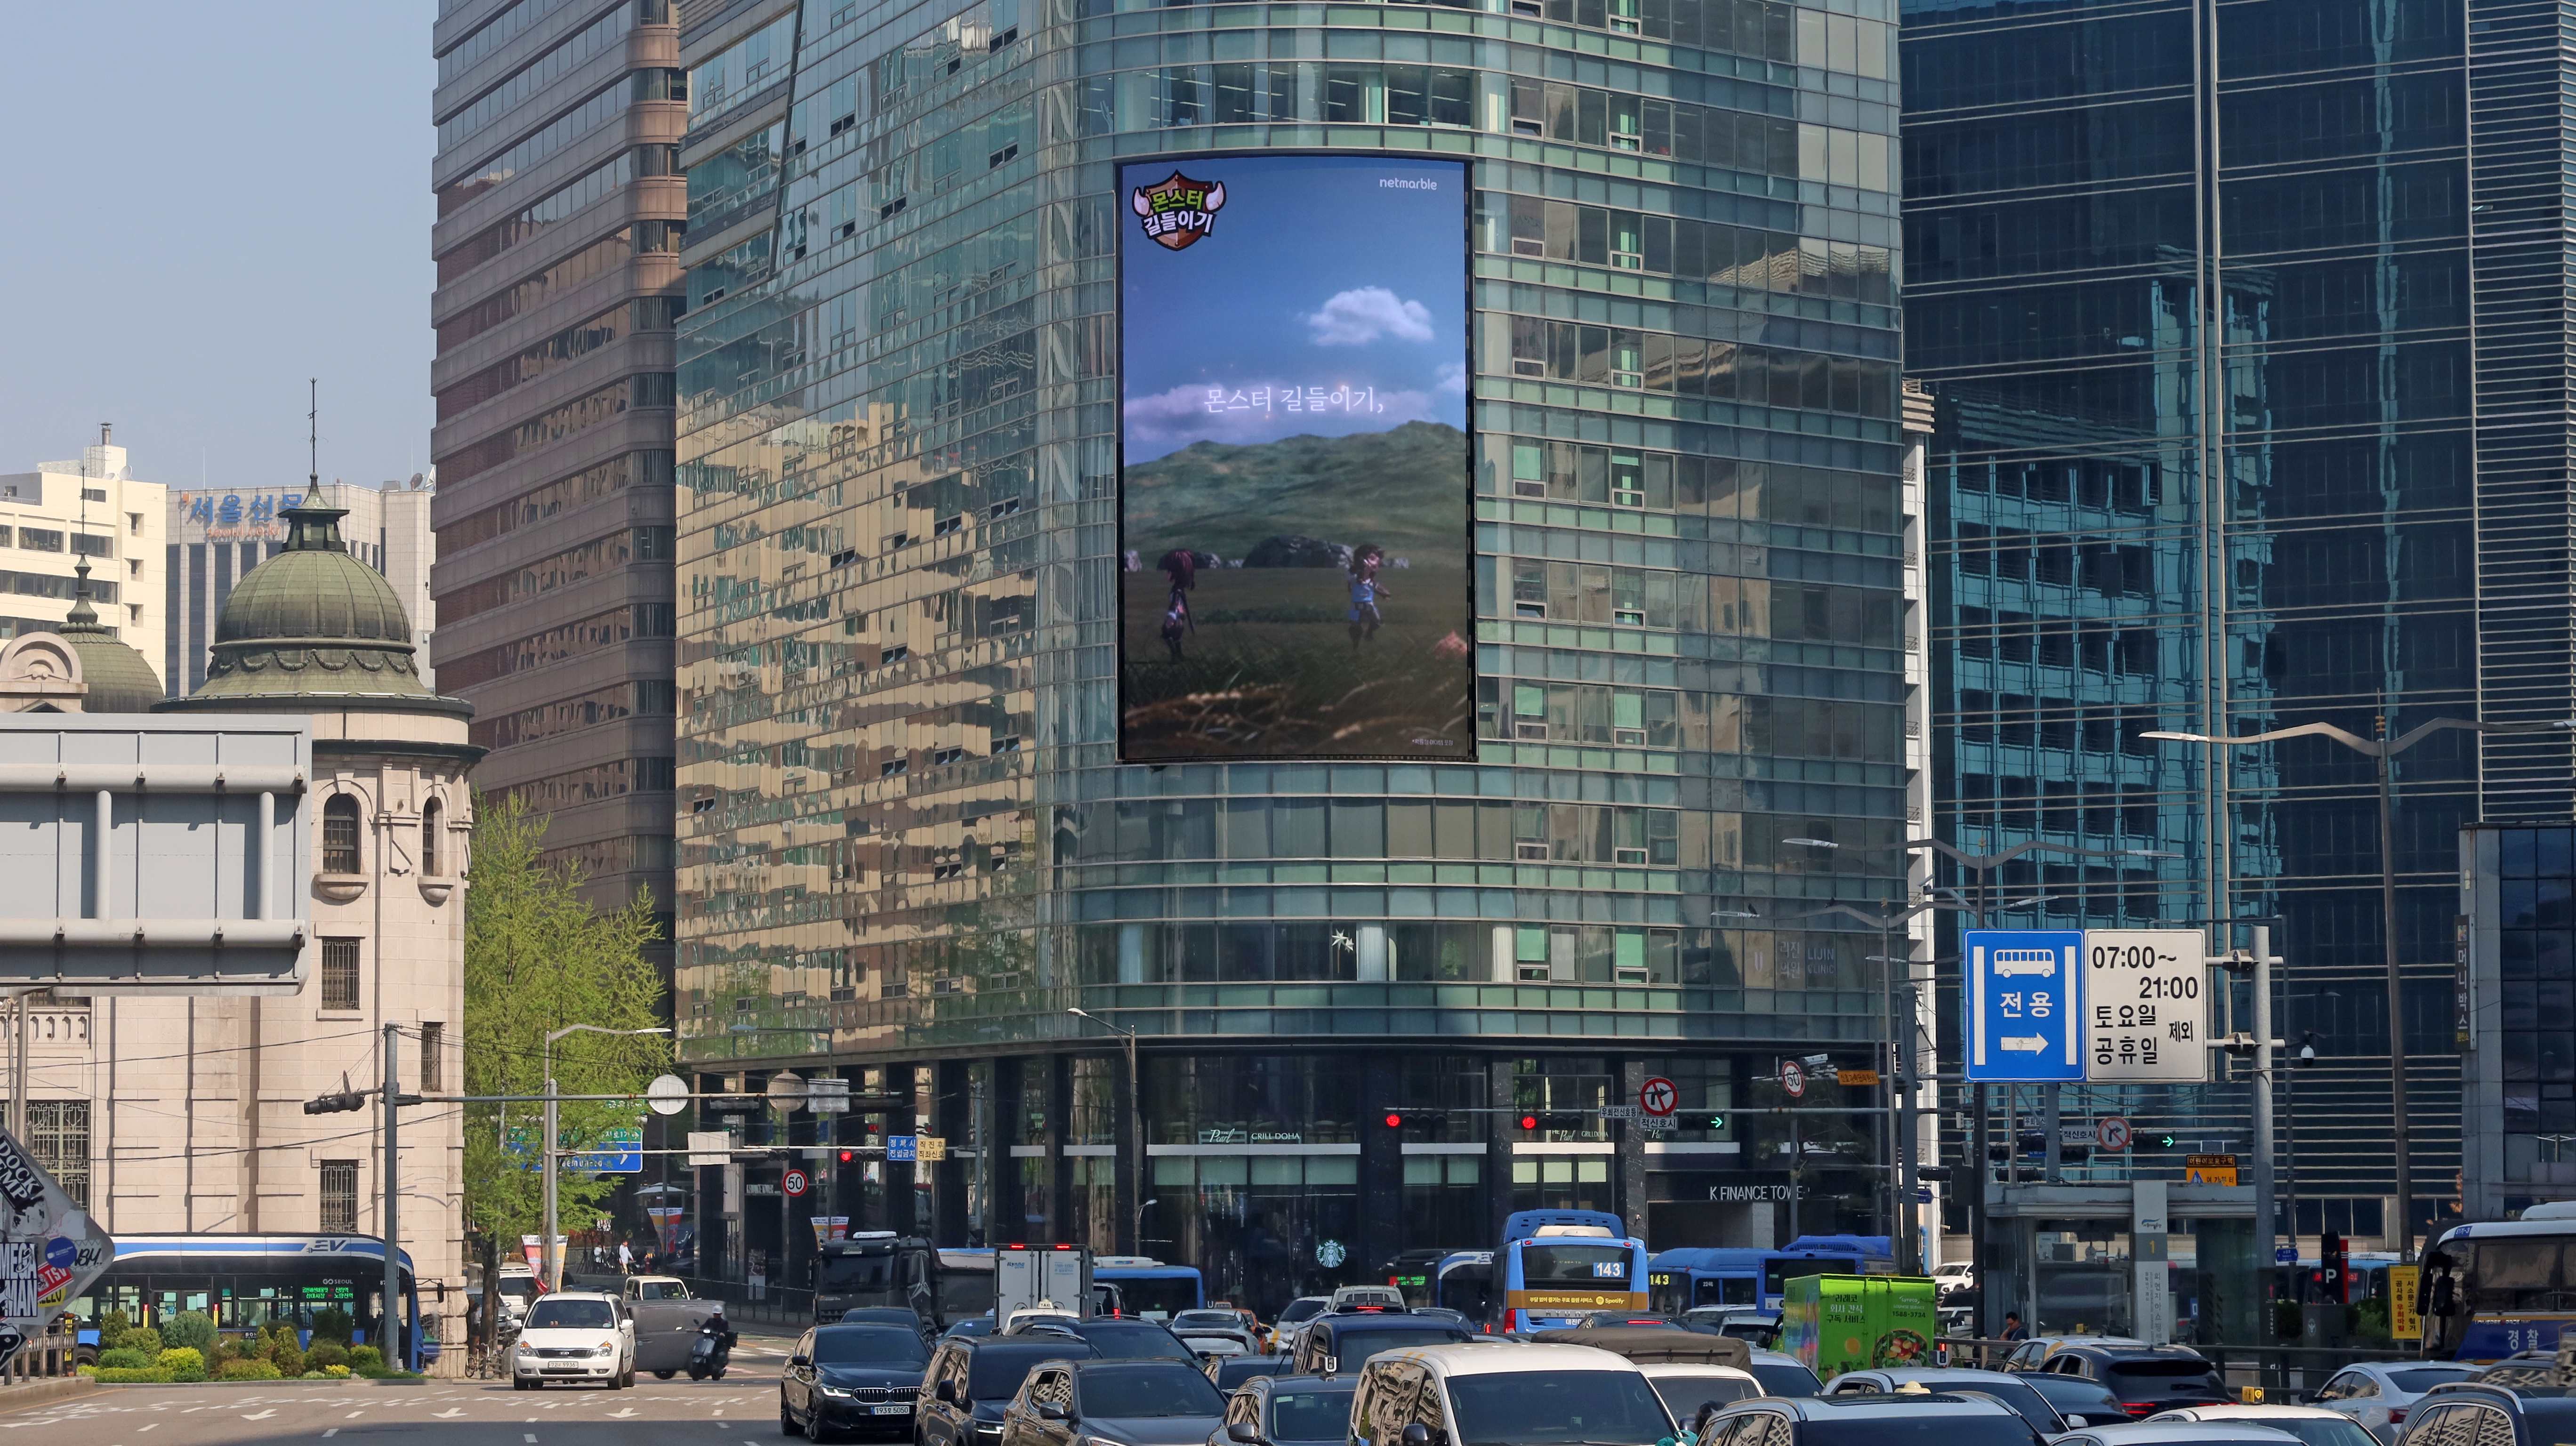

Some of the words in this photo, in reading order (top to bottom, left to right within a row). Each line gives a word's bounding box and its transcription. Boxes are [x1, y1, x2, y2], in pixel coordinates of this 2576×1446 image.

[1379, 177, 1438, 191] netmarble
[1152, 188, 1204, 213] 몬스터
[1143, 210, 1214, 236] 길들이기
[1203, 386, 1272, 413] 몬스터
[1280, 386, 1384, 414] 길들이기,
[207, 523, 282, 539] seoul.co.kr
[1807, 948, 1835, 961] LIJIN
[2139, 976, 2198, 999] 21:00
[2457, 947, 2468, 1030] 머니박스
[2094, 1004, 2156, 1028] 토요일
[2168, 1020, 2194, 1043] 제외
[1787, 1071, 1800, 1086] 50
[1601, 1108, 1637, 1117] 우회전신호등
[1641, 1118, 1676, 1128] 적신호시
[2063, 1131, 2096, 1139] 적신호시
[919, 1141, 943, 1149] 직진후
[890, 1149, 916, 1158] 진입금지
[788, 1177, 803, 1190] 50
[1709, 1186, 1718, 1200] K
[1720, 1185, 1768, 1200] FINANCE
[314, 1239, 347, 1252] EV
[2150, 1240, 2155, 1254] 1
[0, 1243, 37, 1279] MEGA
[1596, 1262, 1621, 1277] 143
[2325, 1269, 2337, 1283] P
[1650, 1274, 1669, 1285] 143
[1830, 1304, 1845, 1313] 회사
[1848, 1304, 1863, 1313] 간식
[1826, 1314, 1842, 1323] 구독
[1844, 1315, 1865, 1324] 서비스
